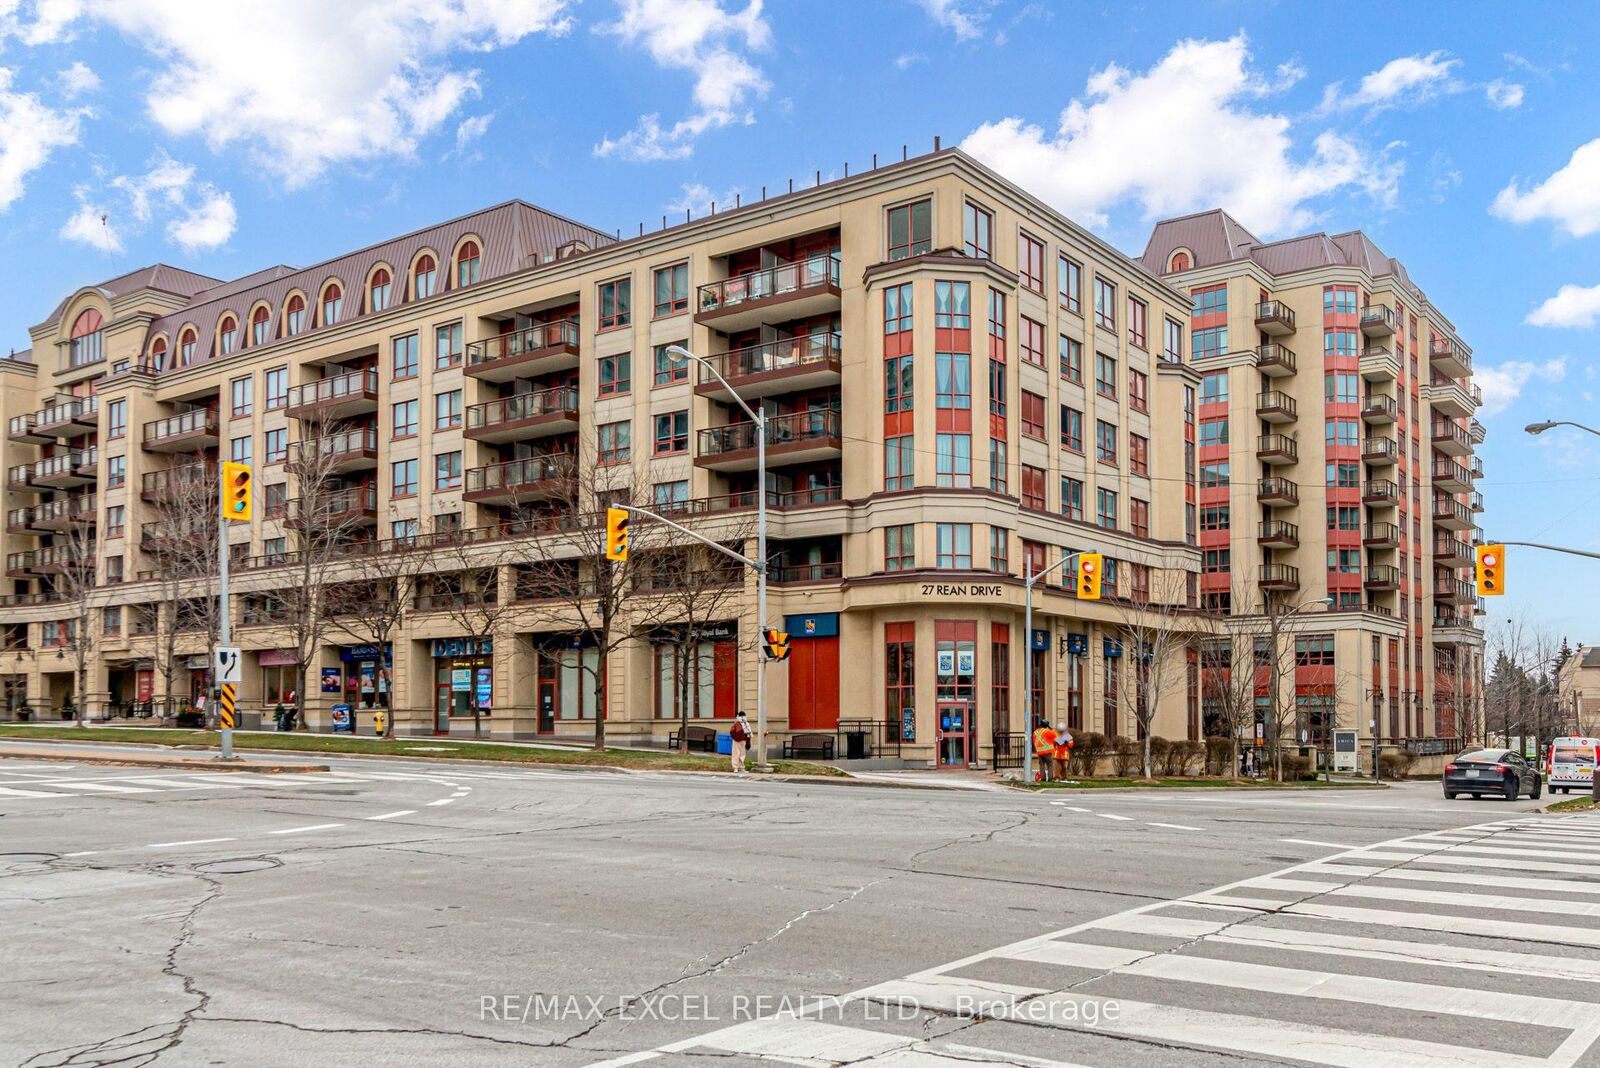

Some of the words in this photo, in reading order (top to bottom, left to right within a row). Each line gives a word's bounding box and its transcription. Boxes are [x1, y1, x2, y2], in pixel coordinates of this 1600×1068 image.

[922, 585, 934, 595] 27
[936, 585, 967, 596] REAN
[970, 586, 1002, 596] DRIVE
[715, 628, 729, 636] Bank
